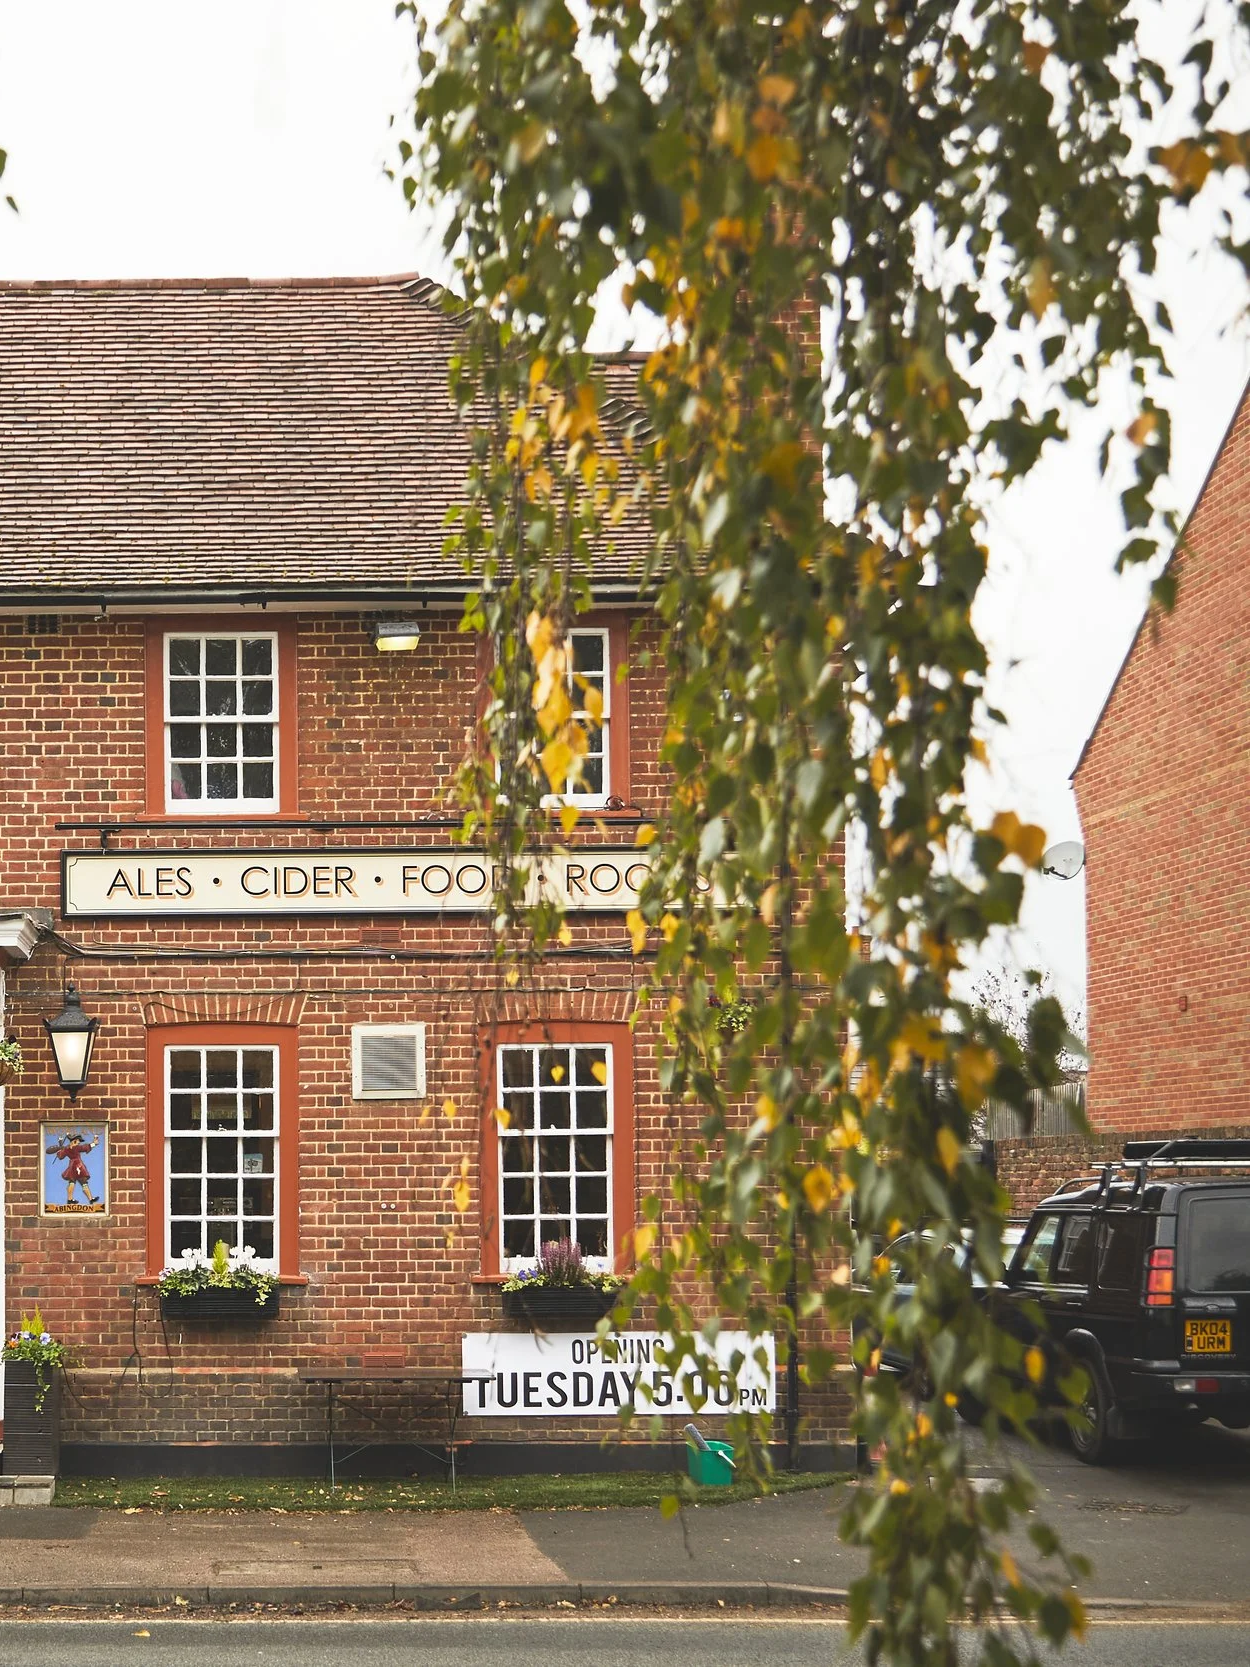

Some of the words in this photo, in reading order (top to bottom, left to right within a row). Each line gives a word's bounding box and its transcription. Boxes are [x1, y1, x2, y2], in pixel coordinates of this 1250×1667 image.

[106, 867, 194, 899] ALES
[240, 866, 356, 897] CIDER
[55, 1204, 94, 1212] ABINGDON
[1190, 1322, 1227, 1335] BK04
[1197, 1336, 1225, 1349] URM
[472, 1371, 642, 1408] TUESDAY
